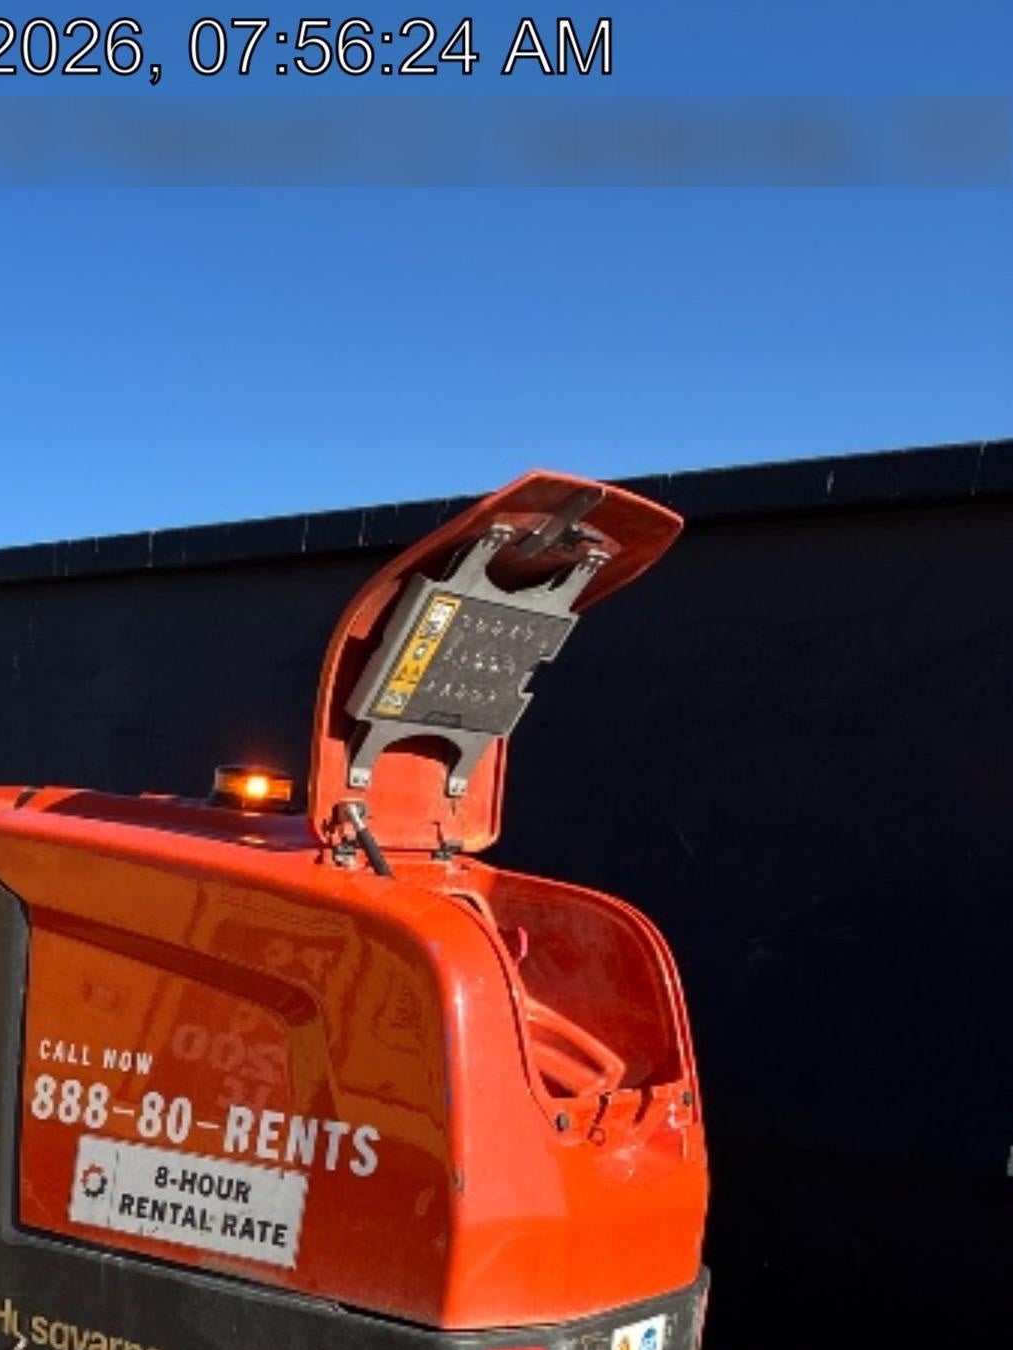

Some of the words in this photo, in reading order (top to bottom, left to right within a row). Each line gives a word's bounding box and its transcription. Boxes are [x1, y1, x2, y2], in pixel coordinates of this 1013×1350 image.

[38, 1038, 92, 1067] CALL
[102, 1048, 153, 1075] NOW
[30, 1073, 382, 1177] 888-80-RENTS
[154, 1166, 251, 1204] 8-HOUR
[118, 1192, 214, 1233] RENTAL
[220, 1213, 289, 1248] RATE
